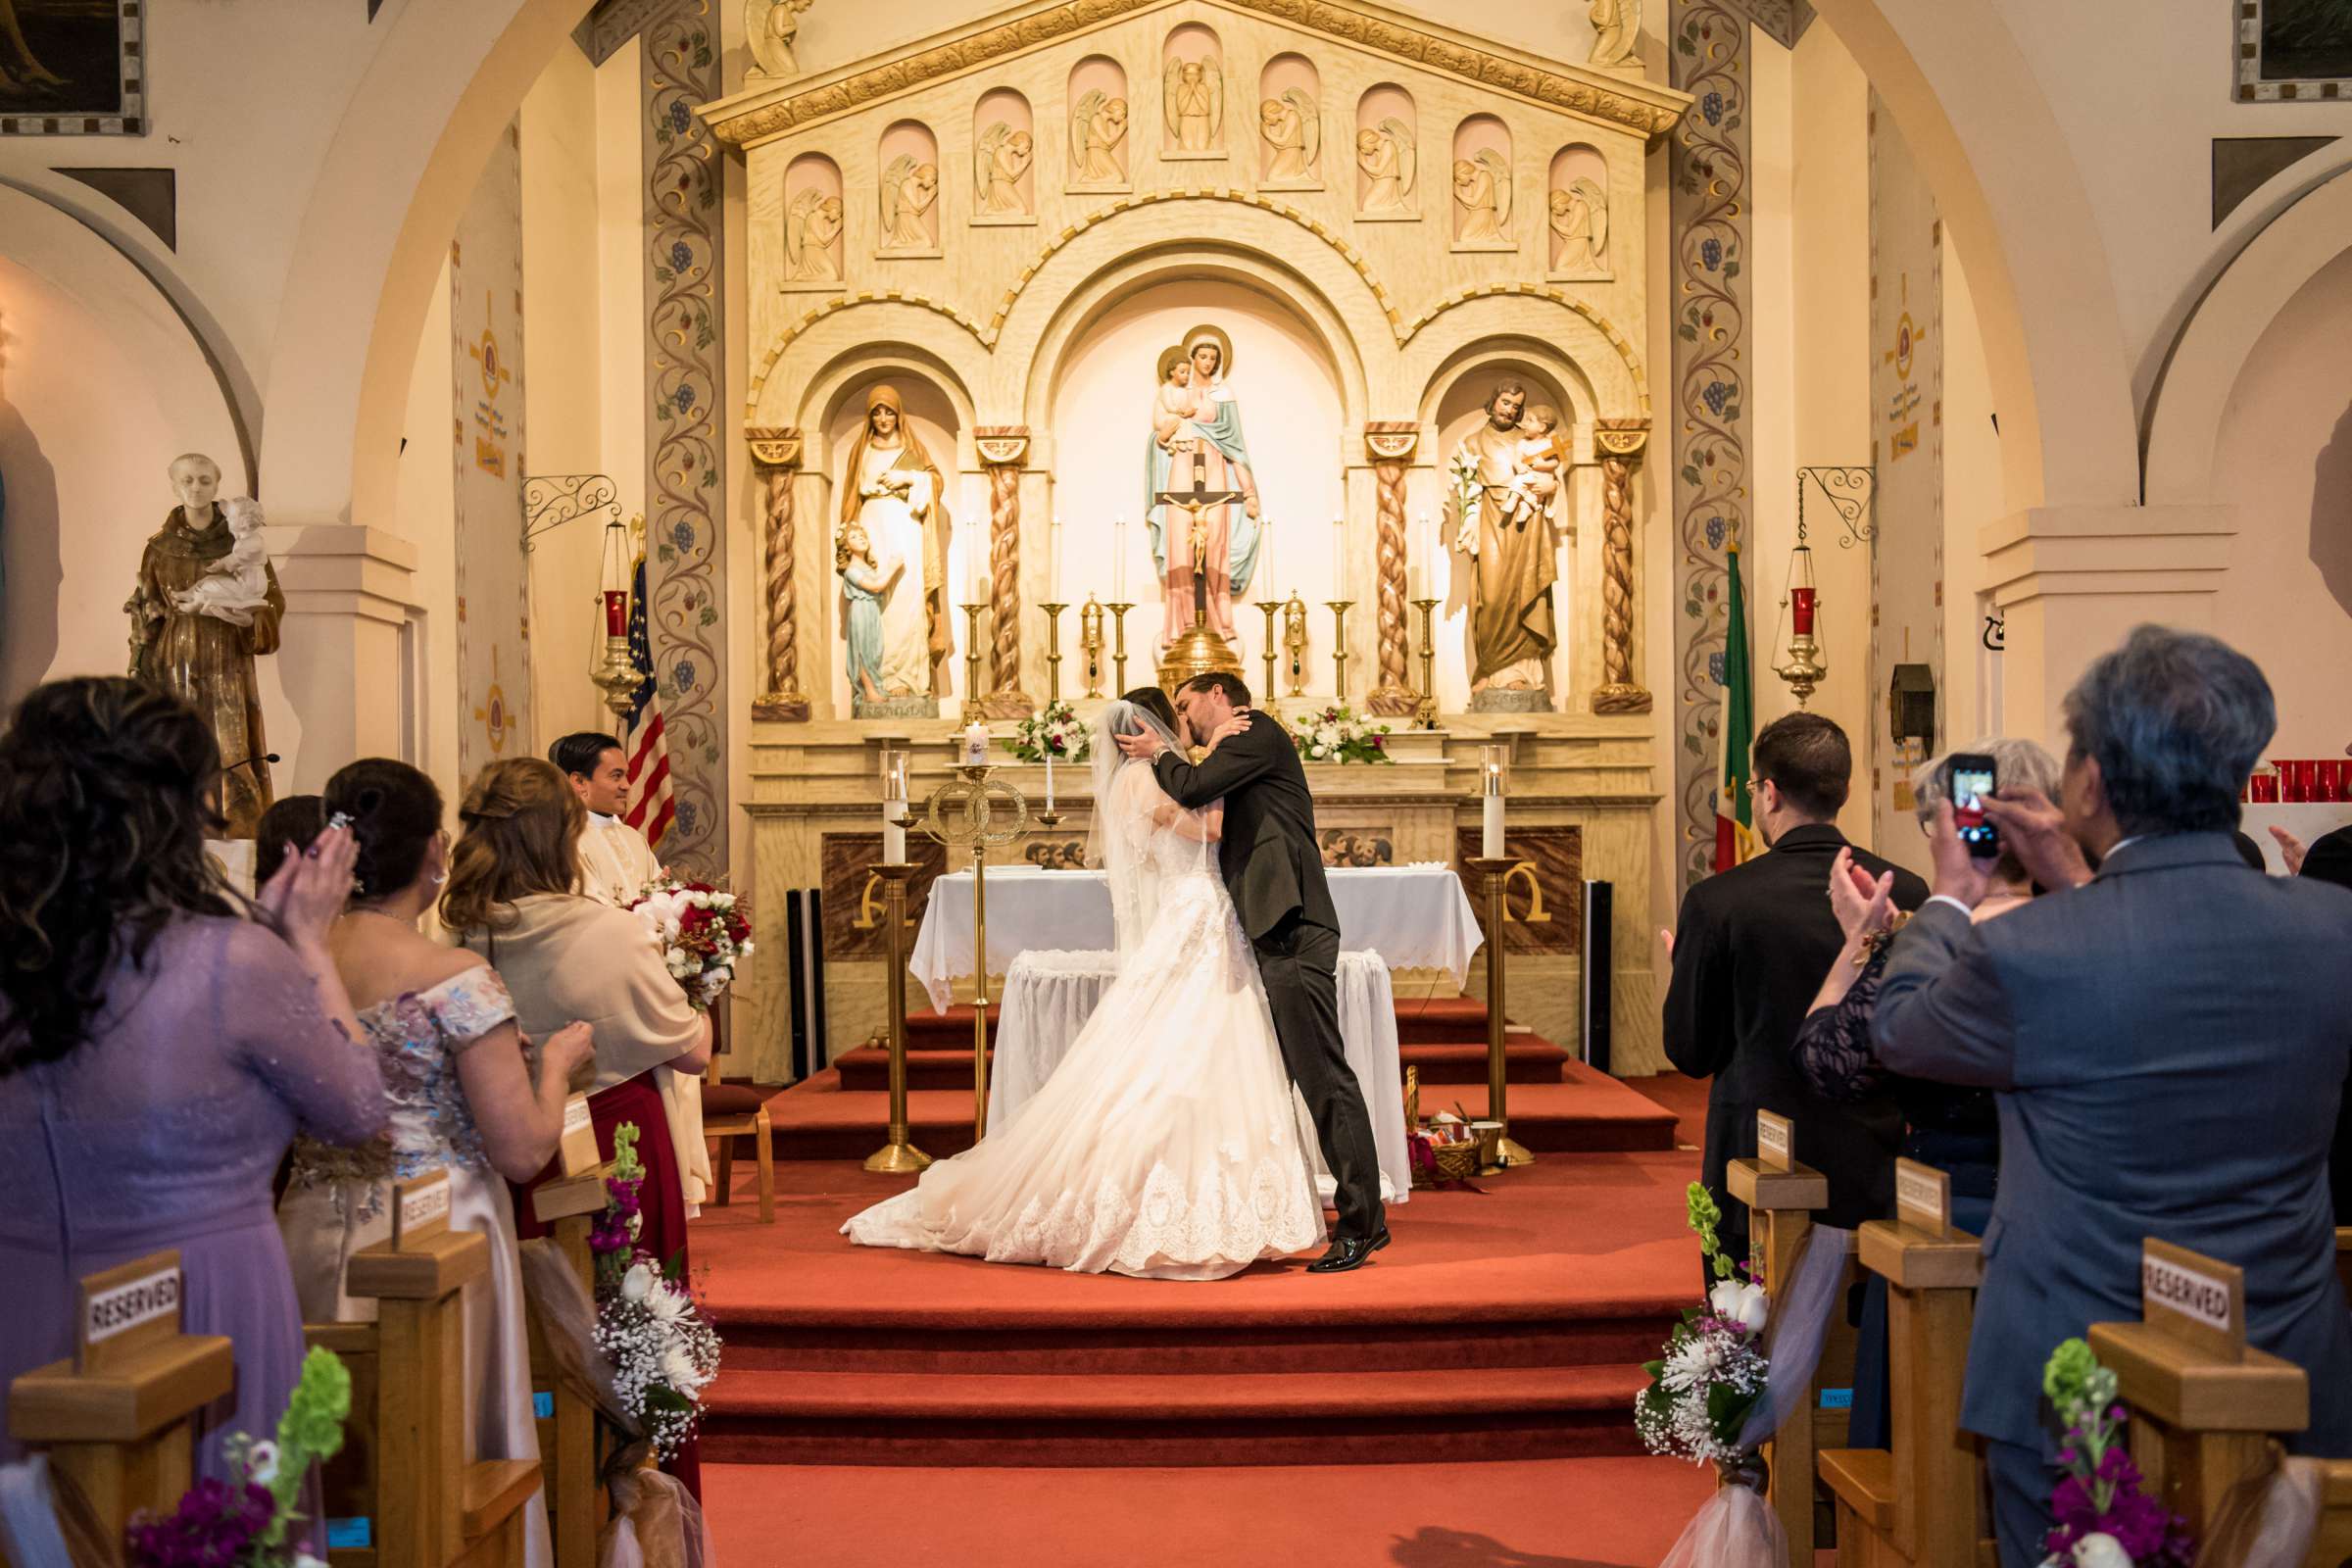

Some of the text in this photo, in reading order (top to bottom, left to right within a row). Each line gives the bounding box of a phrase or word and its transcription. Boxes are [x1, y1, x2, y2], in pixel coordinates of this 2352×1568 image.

[1758, 1121, 1787, 1148] RESERVED
[1897, 1174, 1938, 1208] RESERVED
[91, 1277, 177, 1331] RESERVED
[2145, 1264, 2227, 1319] RESERVED
